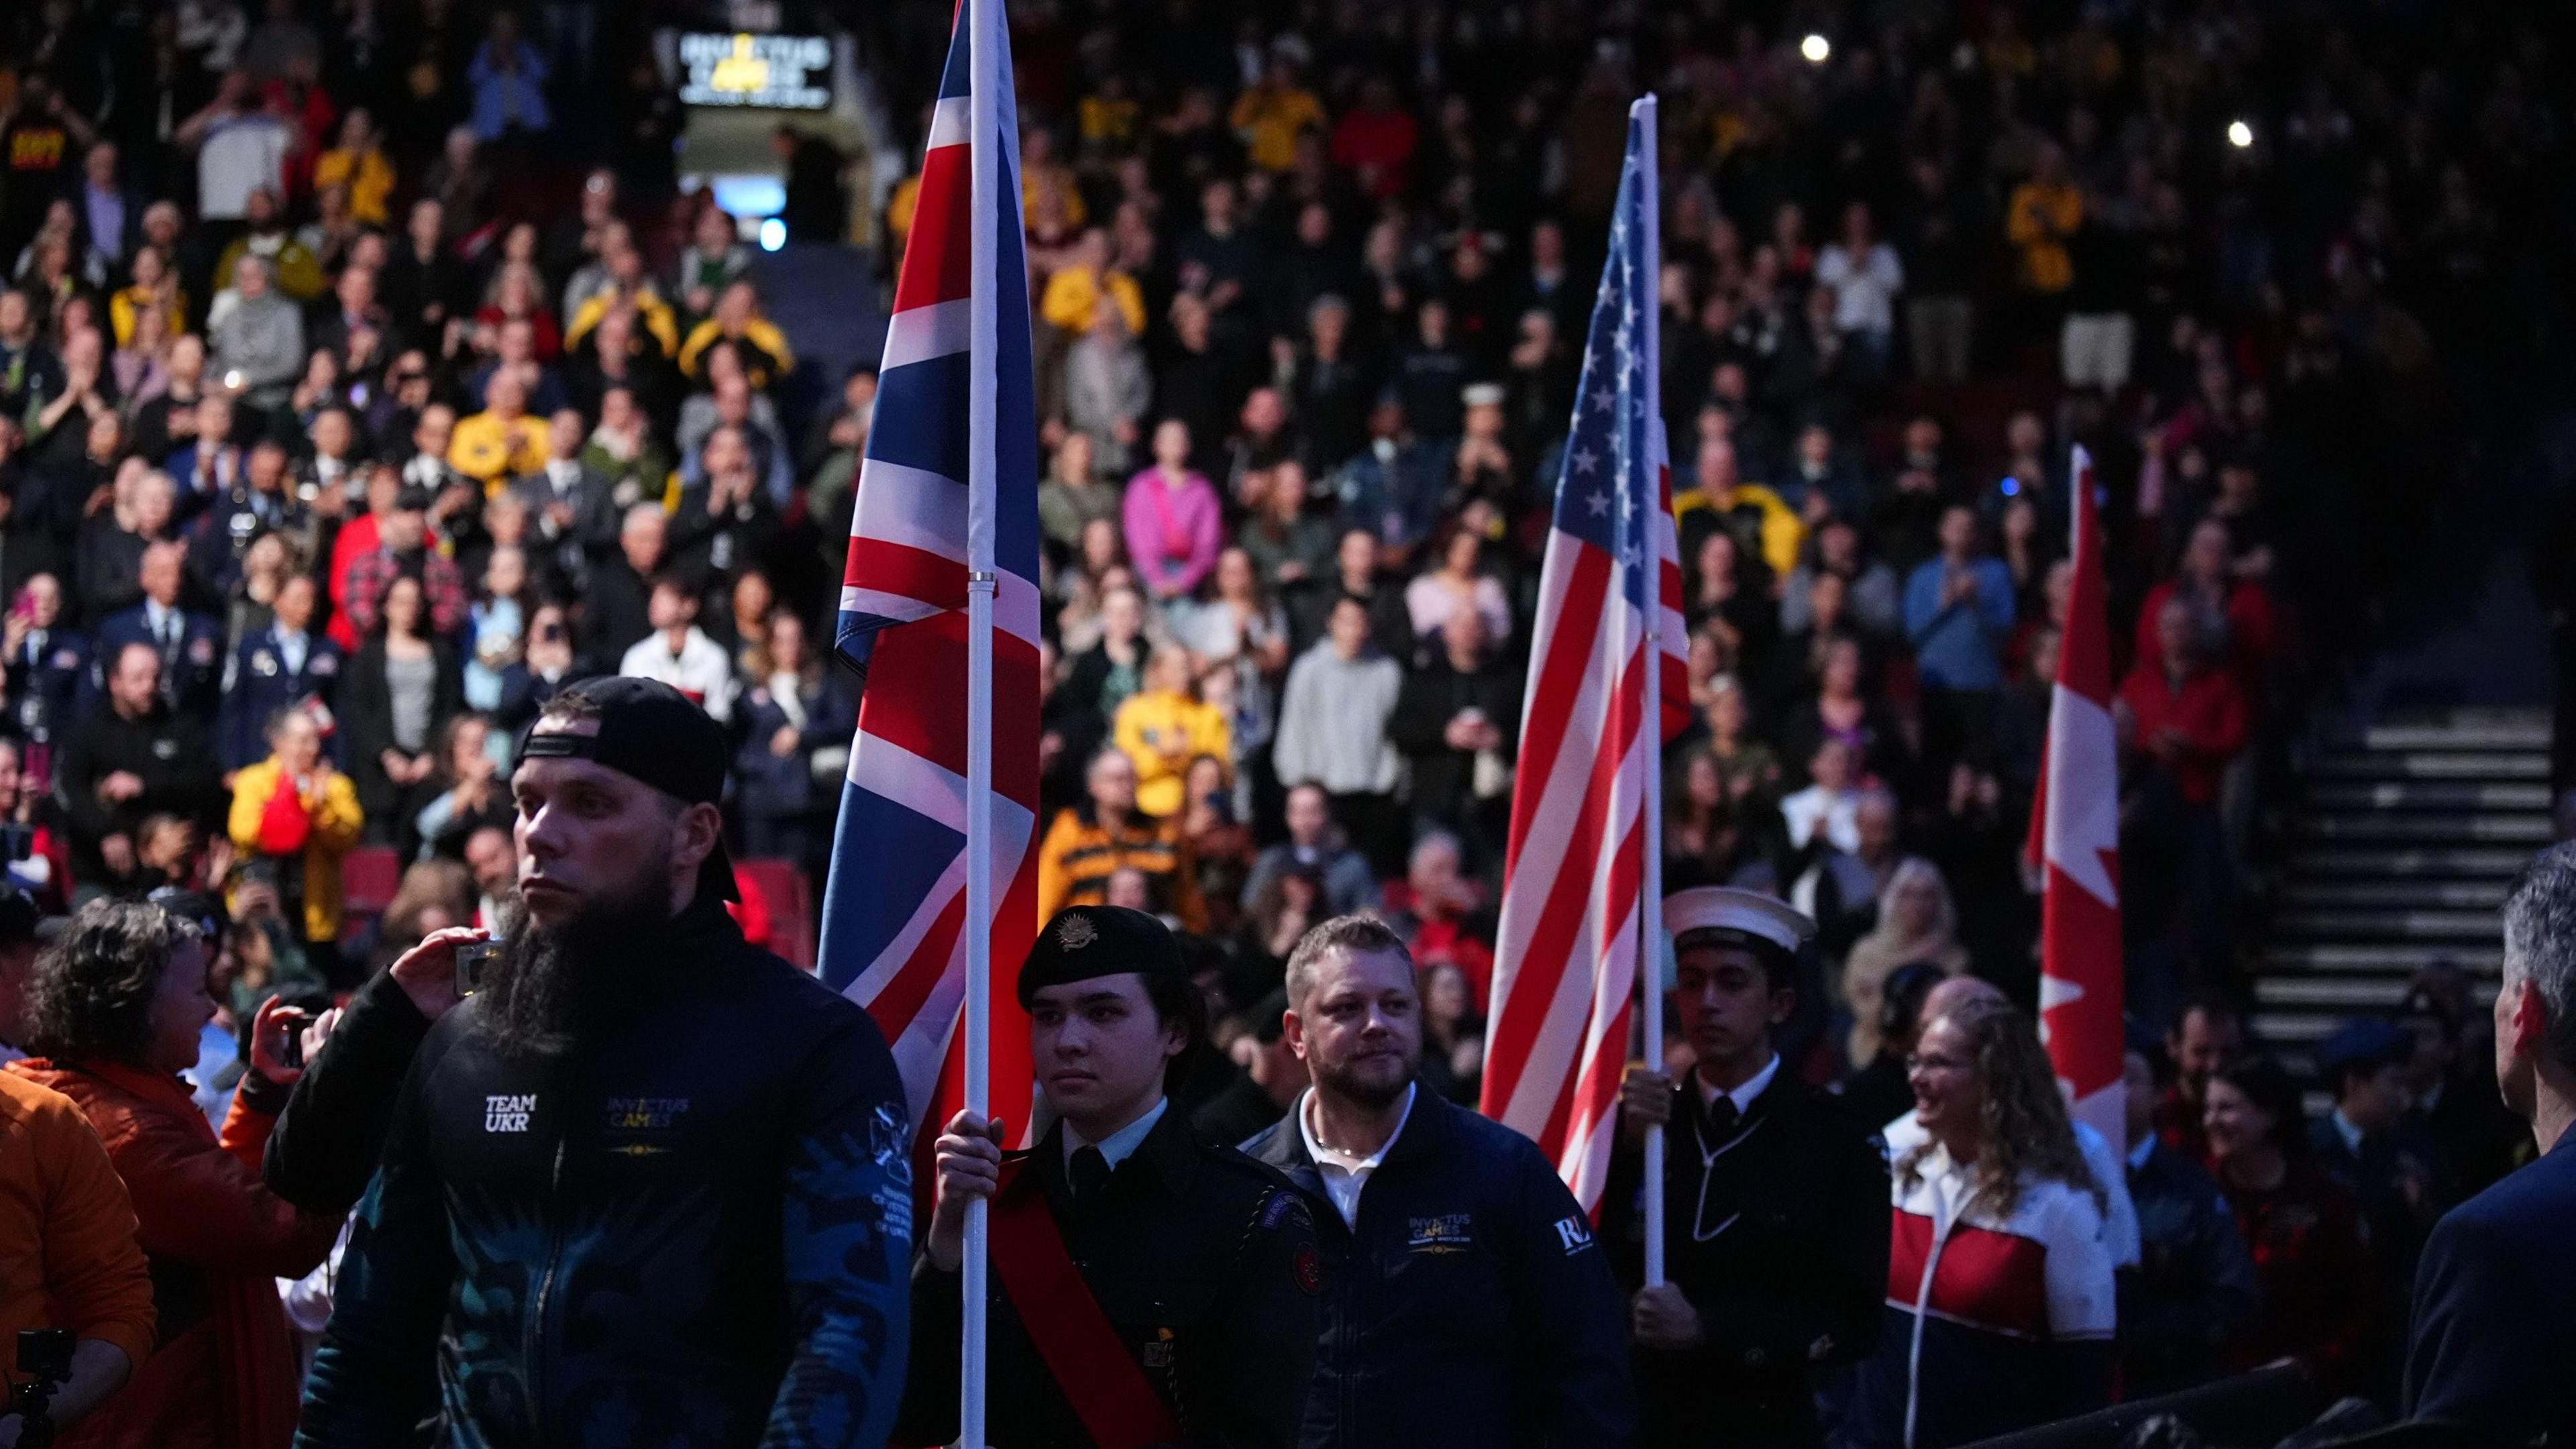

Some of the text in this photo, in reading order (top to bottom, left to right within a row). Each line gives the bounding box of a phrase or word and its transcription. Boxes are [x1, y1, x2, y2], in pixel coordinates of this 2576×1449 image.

[486, 1093, 537, 1112] TEAM
[485, 1113, 530, 1132] UKR
[1409, 1214, 1470, 1228] INVICTUS
[1413, 1225, 1460, 1240] GAMES
